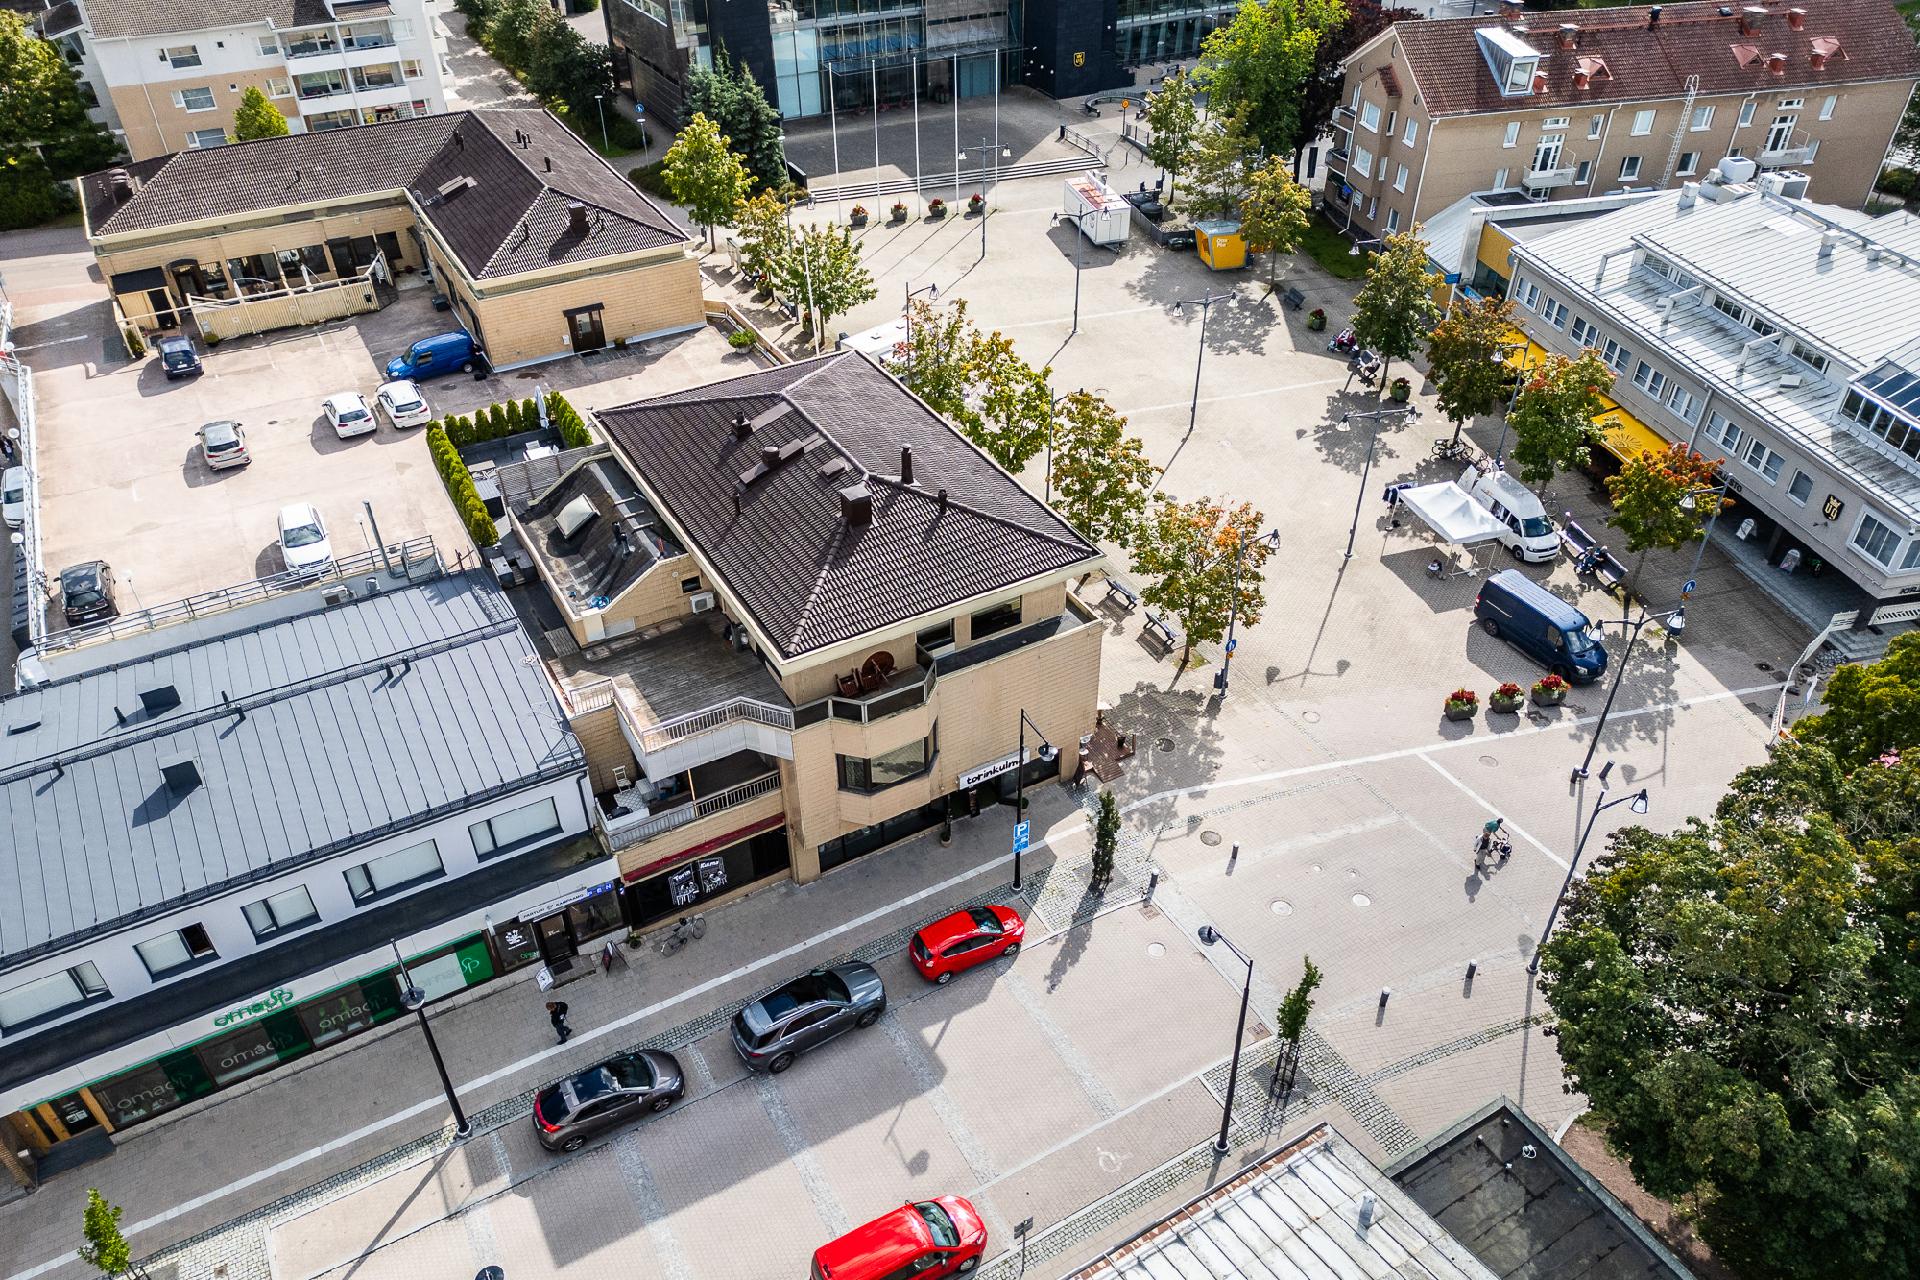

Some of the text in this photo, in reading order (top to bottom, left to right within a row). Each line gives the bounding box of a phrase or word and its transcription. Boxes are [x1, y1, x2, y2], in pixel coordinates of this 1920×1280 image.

[1017, 823, 1028, 836] P
[700, 860, 719, 869] Kulma
[673, 870, 691, 882] Torin
